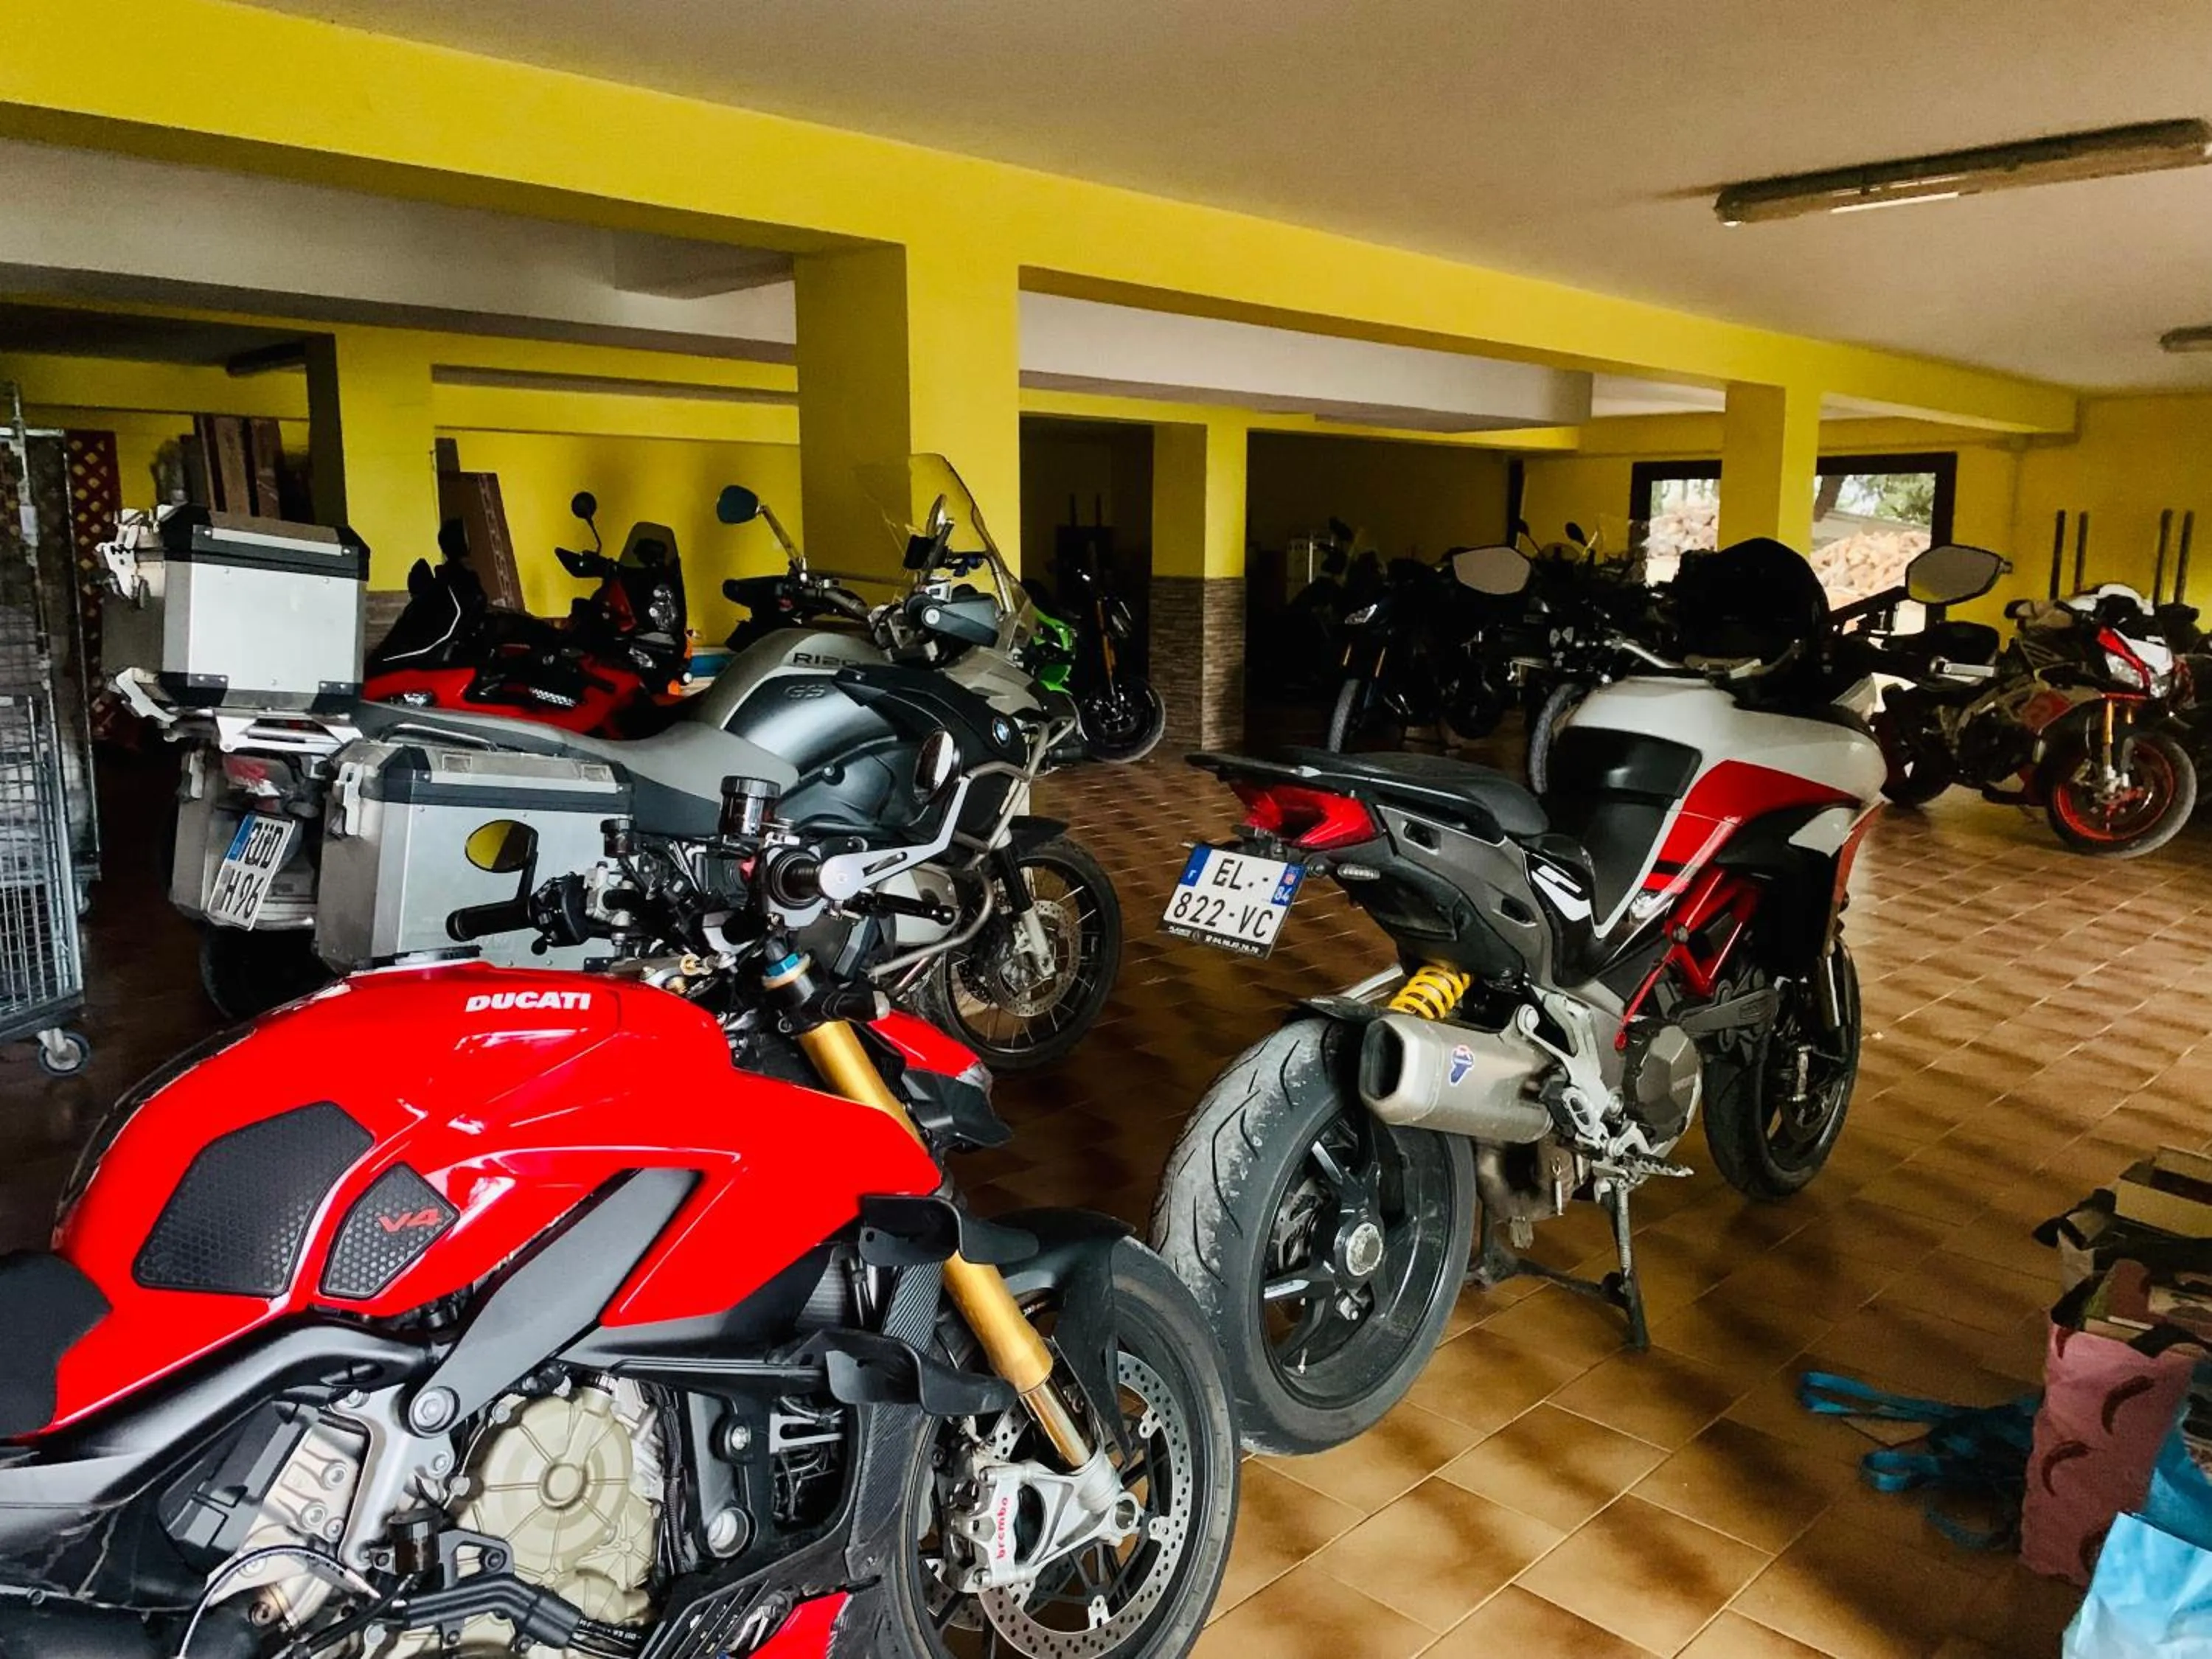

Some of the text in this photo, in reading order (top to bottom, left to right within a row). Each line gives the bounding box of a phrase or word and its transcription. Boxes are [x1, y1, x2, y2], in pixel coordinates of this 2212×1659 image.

[785, 684, 826, 700] GS
[1273, 886, 1293, 901] 84
[1173, 891, 1273, 939] 822-VC
[465, 991, 592, 1012] DUCATI
[378, 1207, 442, 1233] V4
[996, 1498, 1008, 1559] brembo
